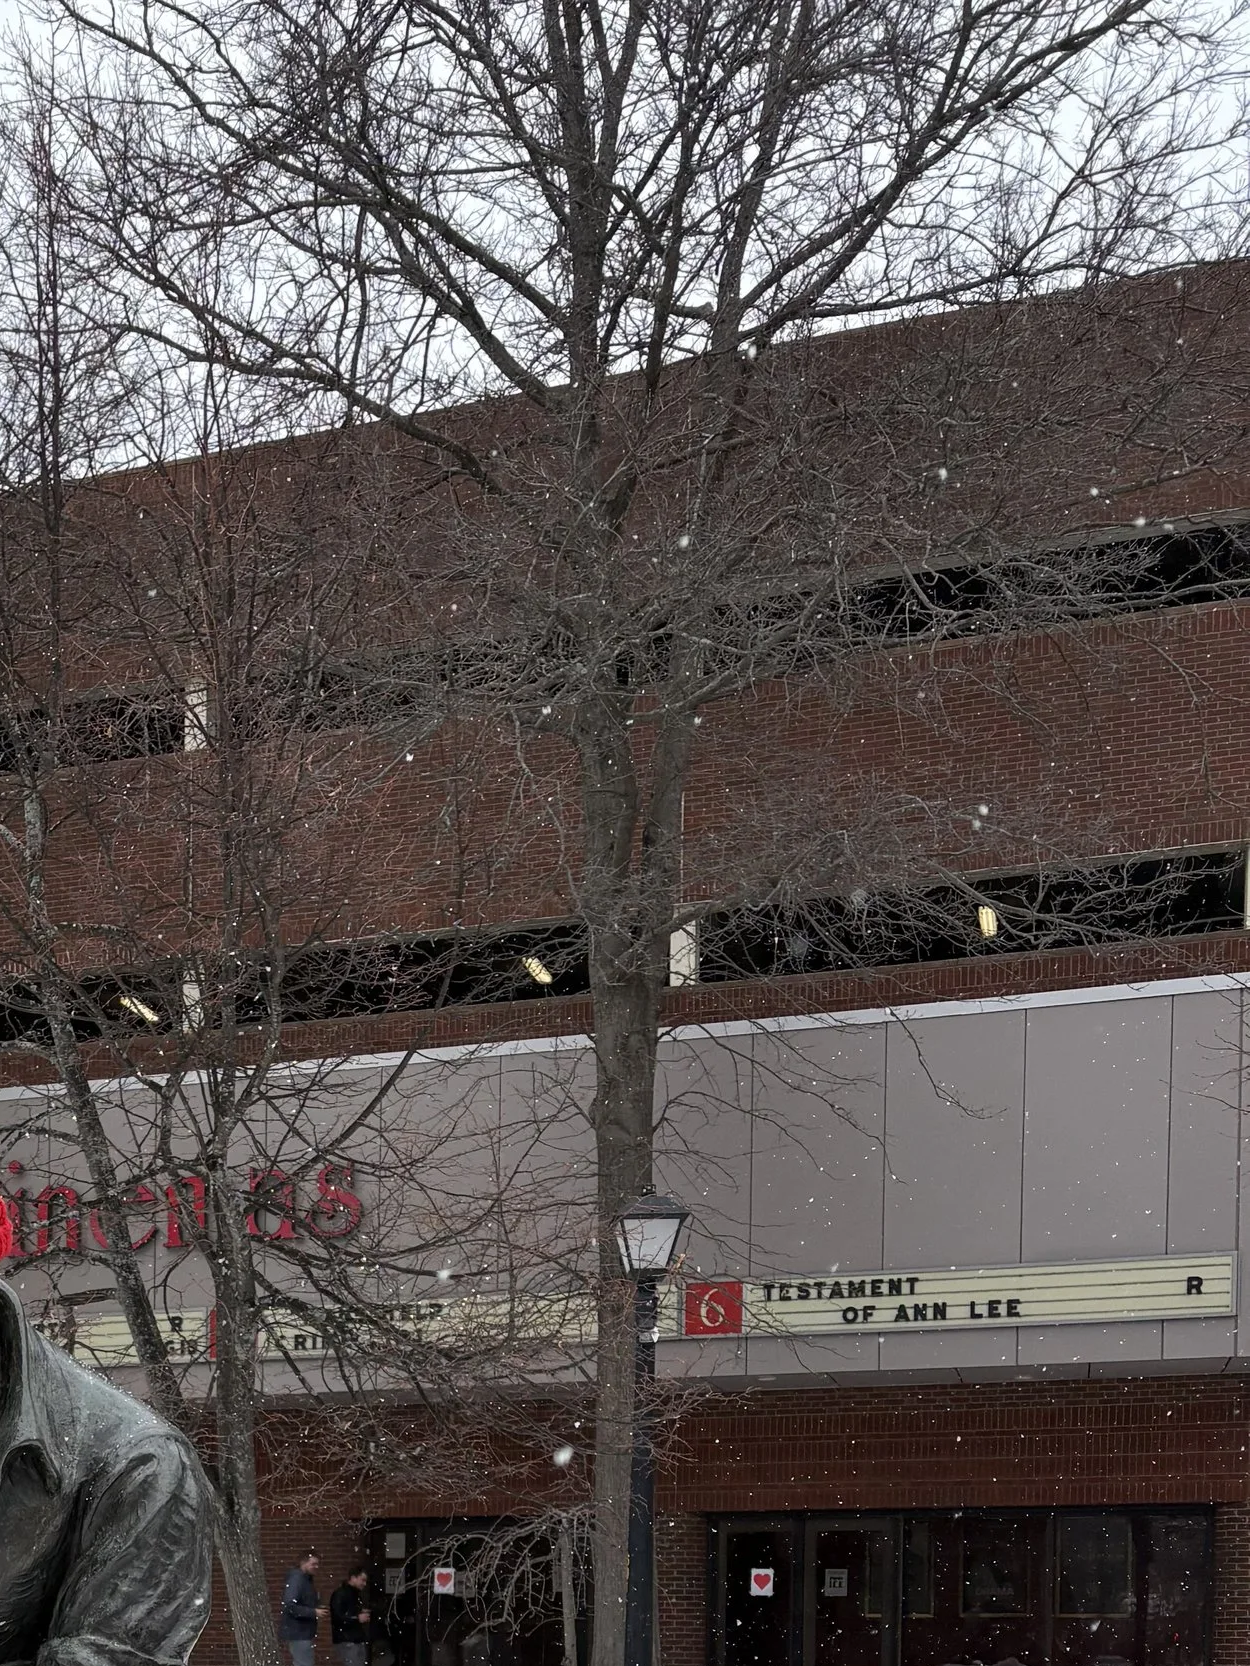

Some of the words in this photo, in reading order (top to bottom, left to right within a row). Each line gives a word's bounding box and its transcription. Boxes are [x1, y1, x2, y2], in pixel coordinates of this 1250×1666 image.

[762, 1277, 920, 1302] TESTAMENT
[1187, 1276, 1204, 1296] R
[699, 1287, 726, 1328] 6
[842, 1305, 877, 1324] OF
[894, 1301, 948, 1322] ANN
[969, 1298, 1023, 1319] LEE
